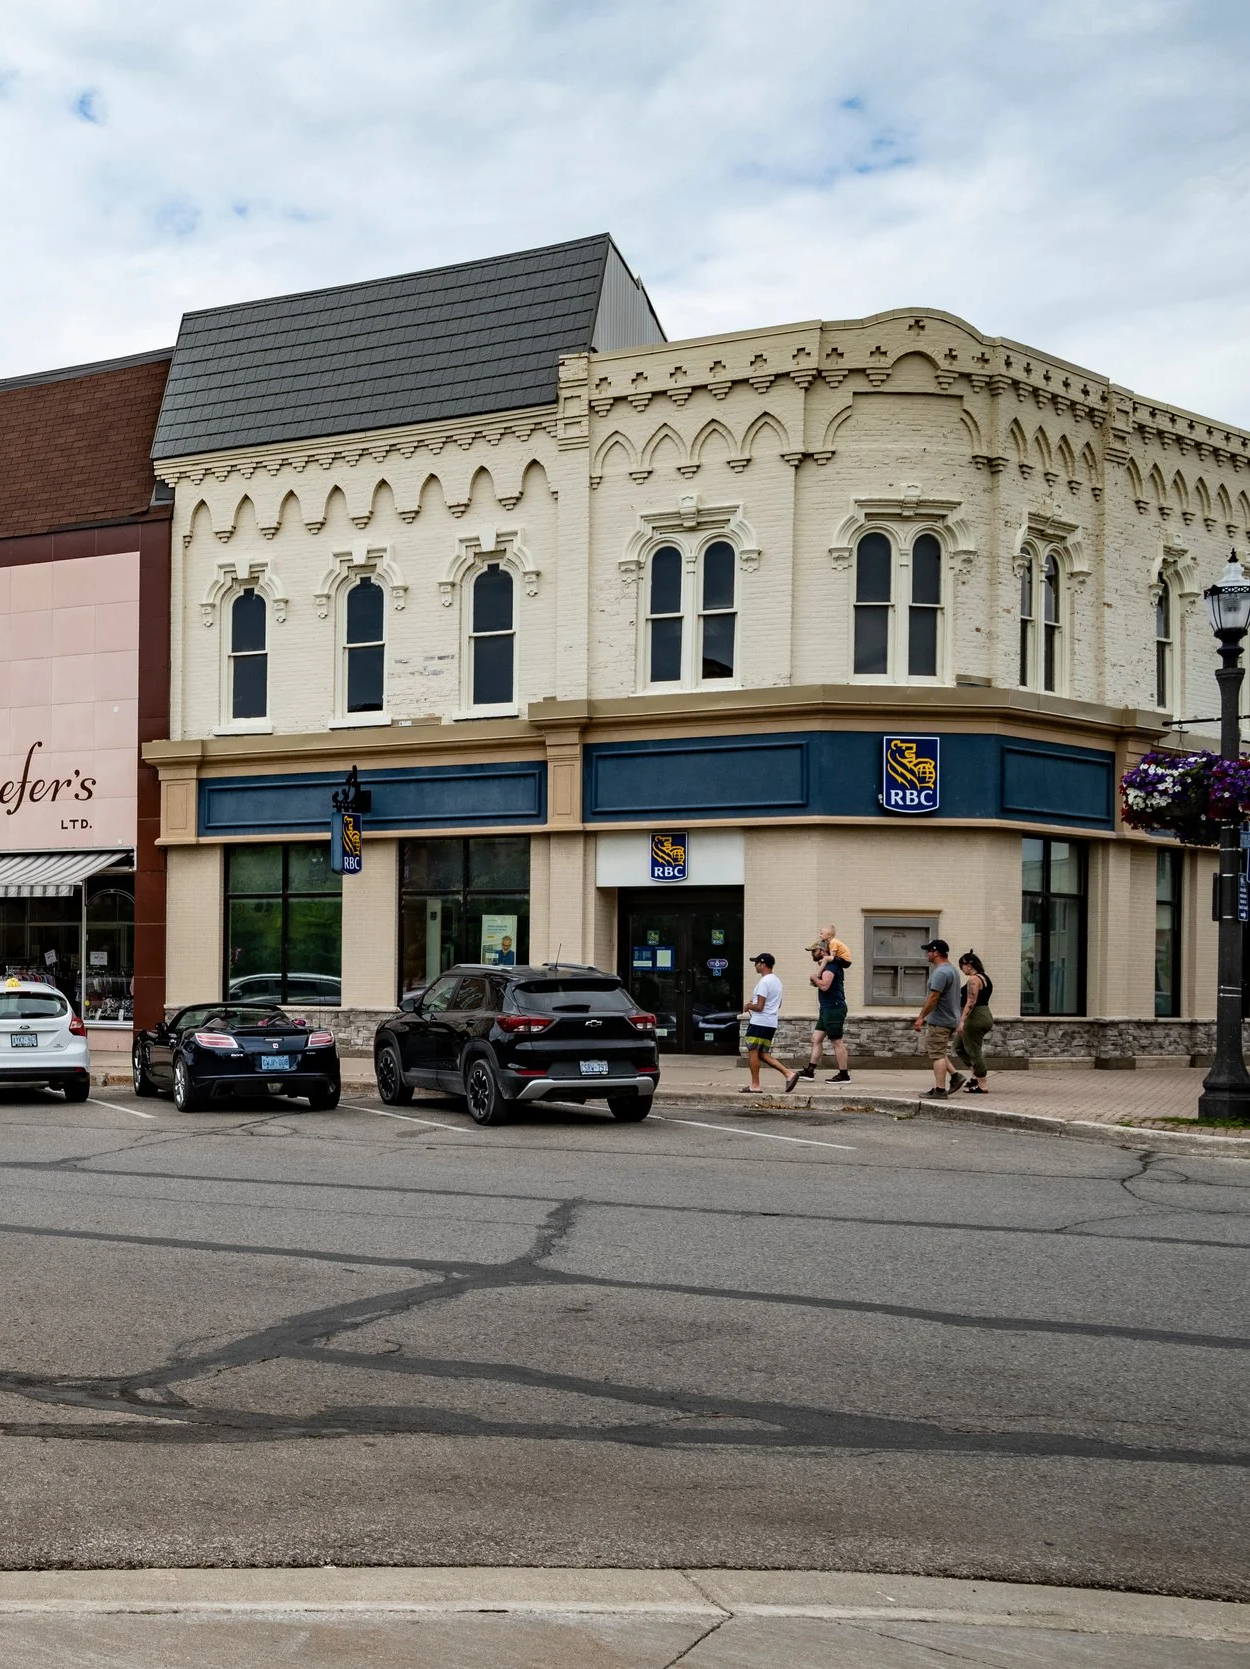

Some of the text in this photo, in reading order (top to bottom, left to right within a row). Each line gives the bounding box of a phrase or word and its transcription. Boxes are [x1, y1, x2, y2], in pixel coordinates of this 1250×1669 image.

[889, 789, 934, 806] RBC
[60, 818, 93, 830] LTD.
[343, 856, 361, 870] RBC
[654, 866, 684, 877] RBC
